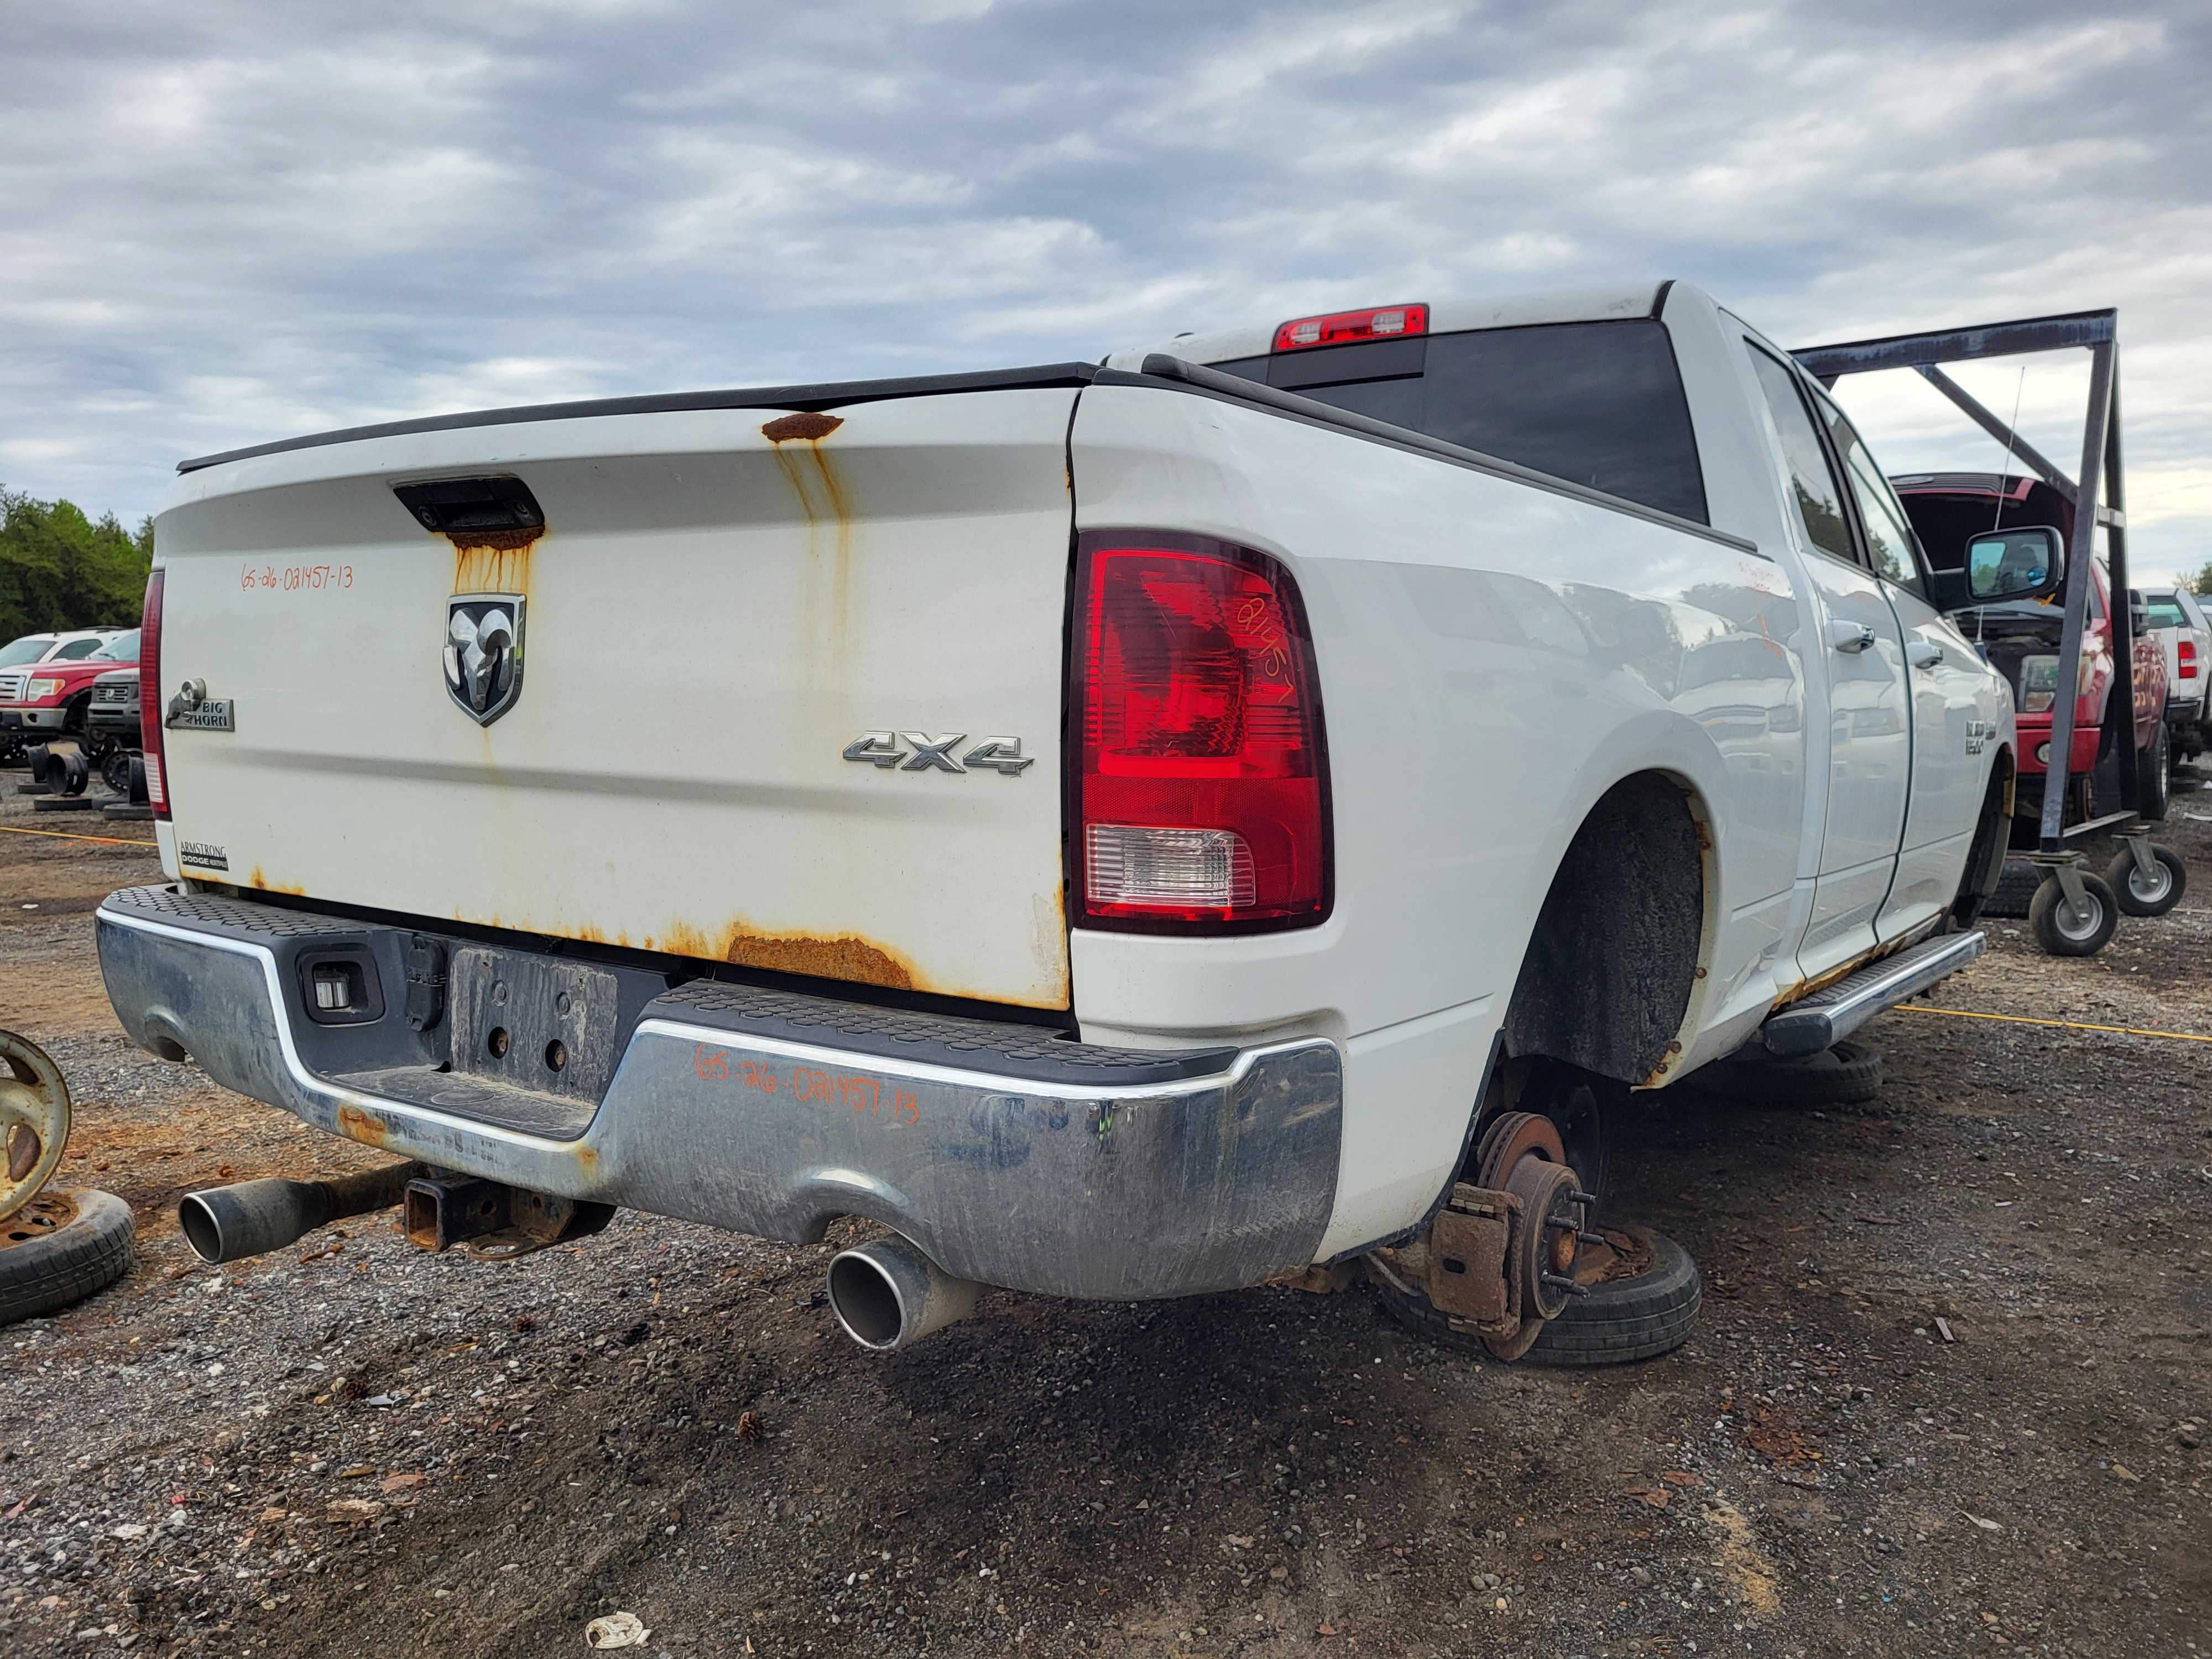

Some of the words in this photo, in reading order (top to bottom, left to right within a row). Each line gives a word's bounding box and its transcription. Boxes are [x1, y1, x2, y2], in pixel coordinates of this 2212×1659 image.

[202, 702, 222, 713] BIG
[194, 715, 227, 727] HORN
[842, 730, 1035, 775] 4X4
[181, 841, 227, 858] ARMSTRONG
[182, 855, 210, 865] DODGE
